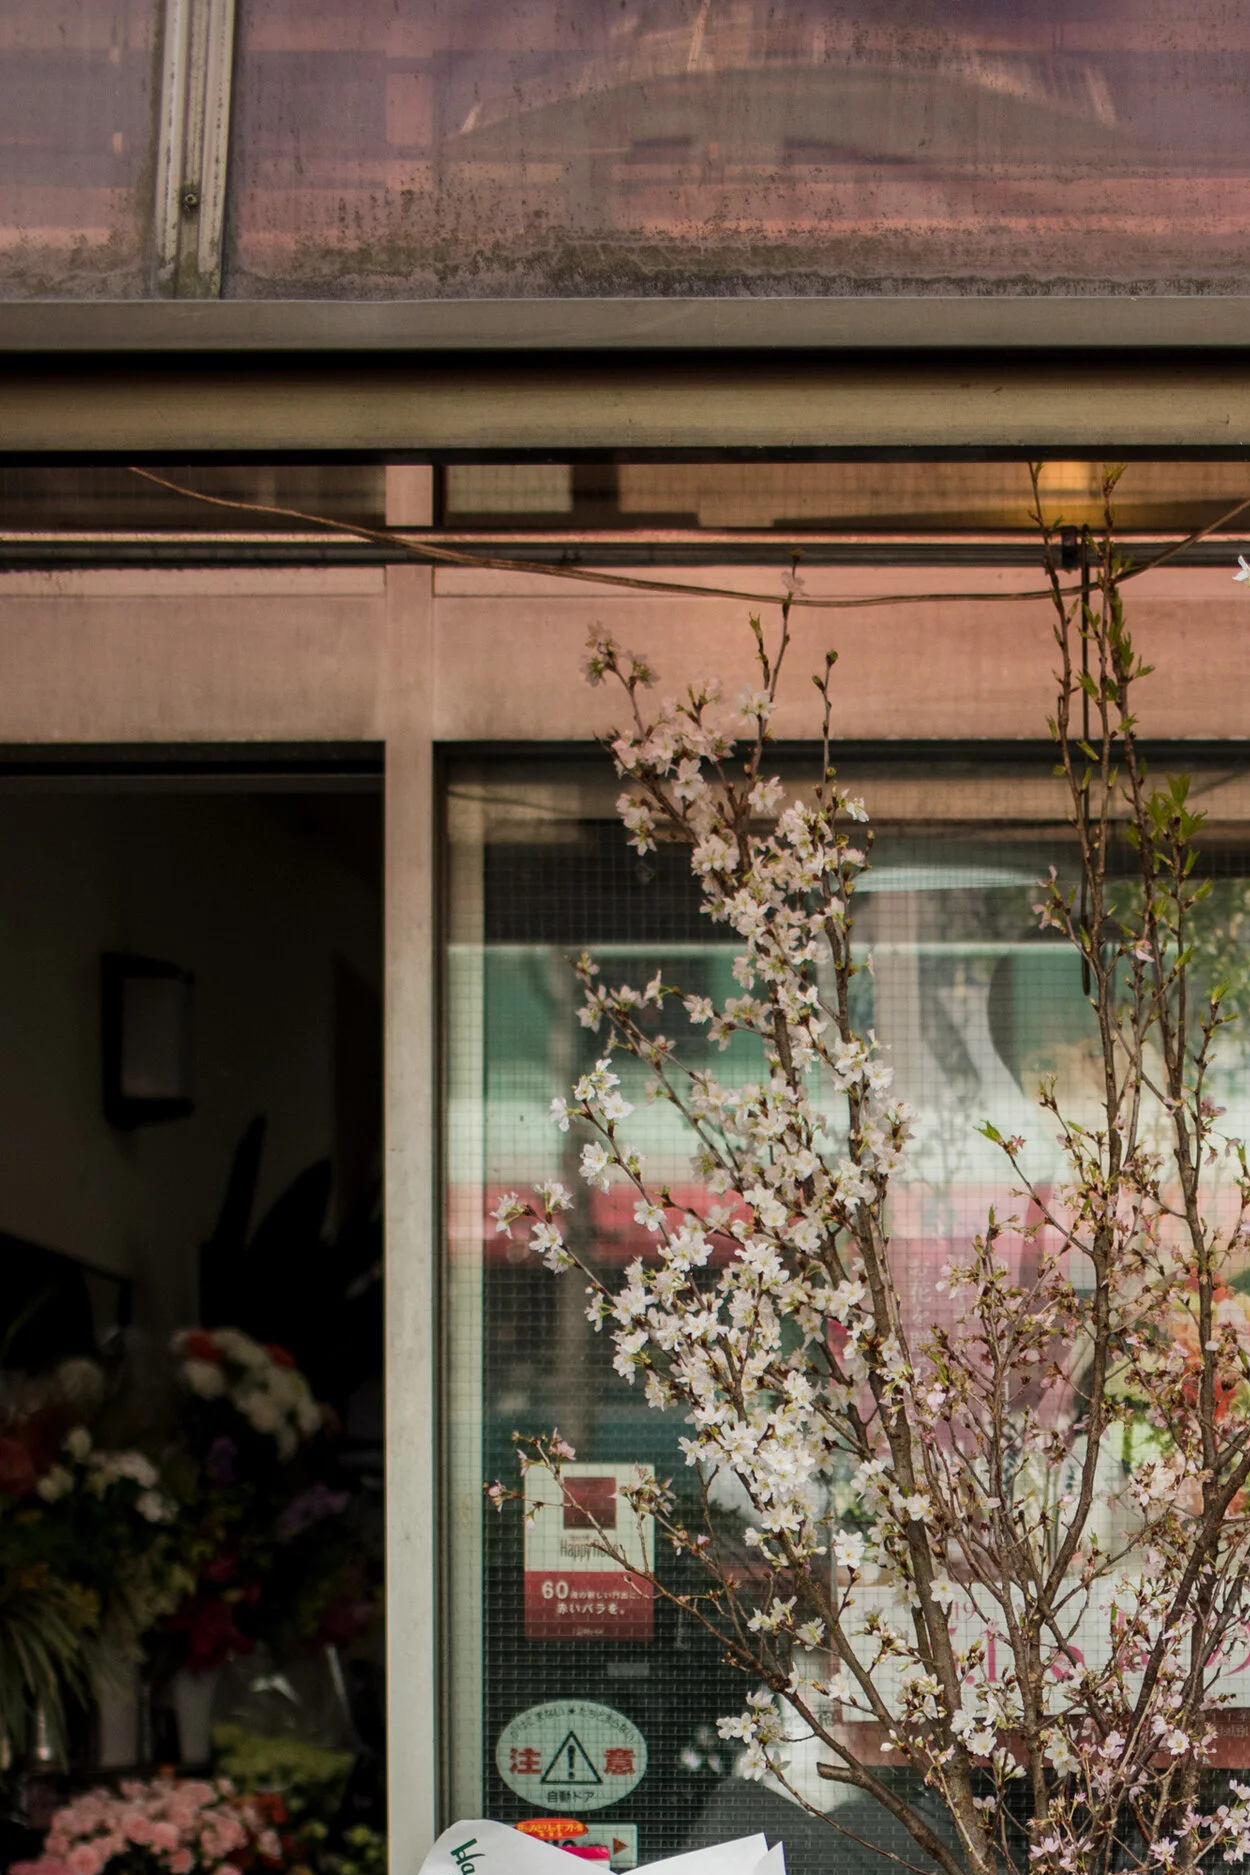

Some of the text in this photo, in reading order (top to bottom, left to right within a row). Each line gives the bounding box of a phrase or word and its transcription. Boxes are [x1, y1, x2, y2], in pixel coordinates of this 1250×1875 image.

[509, 1747, 635, 1775] 注 意
[547, 1791, 595, 1803] 自動ドア
